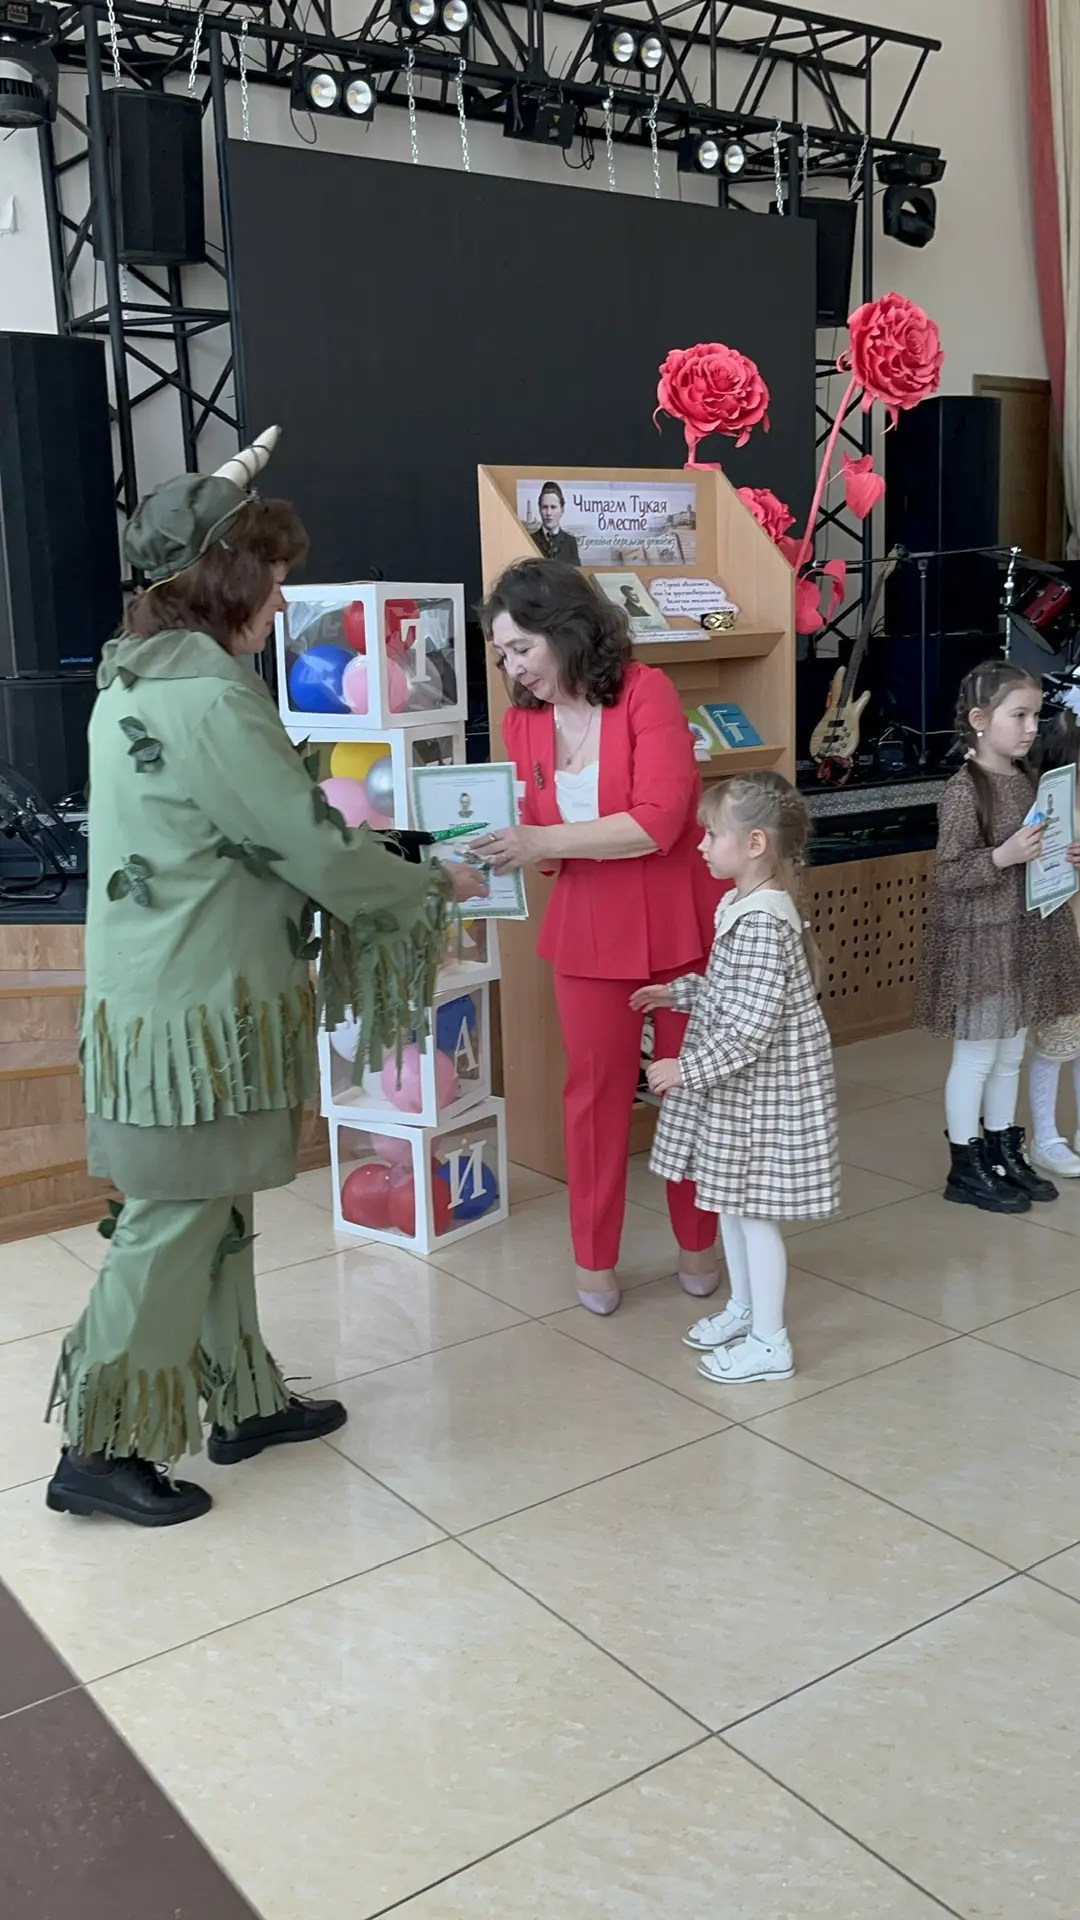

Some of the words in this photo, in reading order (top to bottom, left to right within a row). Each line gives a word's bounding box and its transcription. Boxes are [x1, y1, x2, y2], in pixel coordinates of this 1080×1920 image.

[598, 512, 648, 531] вместе
[630, 495, 667, 518] Тукая
[400, 618, 441, 683] Т
[452, 1015, 479, 1079] А
